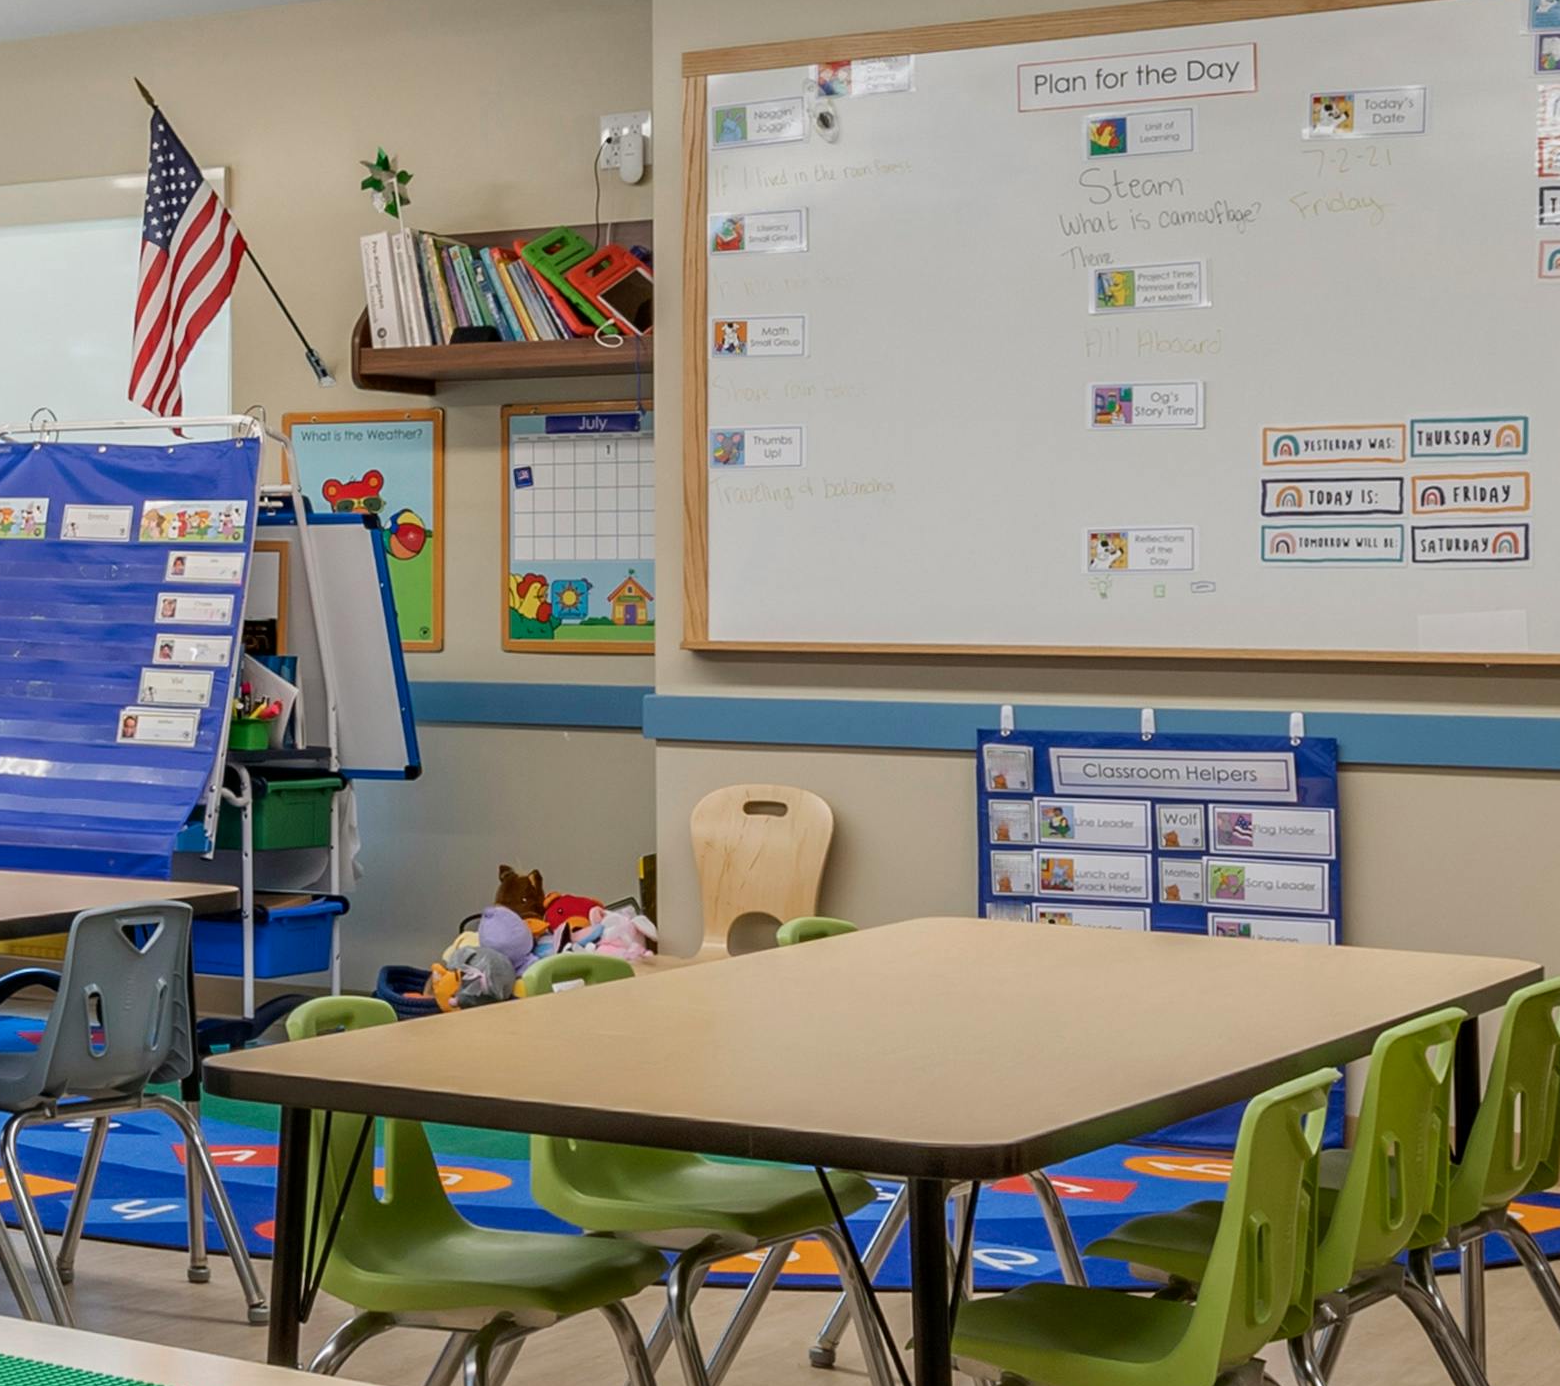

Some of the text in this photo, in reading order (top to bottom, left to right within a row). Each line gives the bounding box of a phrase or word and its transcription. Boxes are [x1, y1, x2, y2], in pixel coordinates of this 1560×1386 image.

[1034, 59, 1240, 96] Plan for the Day
[1364, 97, 1415, 112] Today's
[1372, 112, 1406, 125] Date
[1144, 120, 1174, 132] Unit of
[1139, 132, 1181, 145] Learning
[1079, 167, 1185, 206] Steam
[1288, 191, 1385, 227] Friday
[1059, 211, 1119, 238] What
[1129, 209, 1151, 231] is
[1137, 270, 1170, 283] Project
[1136, 279, 1198, 292] Primrose Early
[1142, 293, 1193, 304] Art Masters
[760, 326, 790, 337] Math
[749, 337, 801, 349] Small Group
[1150, 391, 1180, 406] Og's
[1134, 405, 1195, 419] Story Time
[577, 415, 609, 432] July
[300, 427, 424, 442] What is the Weather?
[752, 435, 794, 446] Thumbs
[1416, 428, 1493, 447] THURSDAY
[1303, 436, 1396, 453] YESTERDAY WAS:
[763, 447, 781, 461] Up!
[1308, 488, 1380, 507] TODAY IS:
[1452, 484, 1512, 504] FRIDAY
[1134, 534, 1186, 545] Reflections
[1298, 536, 1351, 550] TOMORROW
[1355, 536, 1379, 549] WILL
[1420, 537, 1490, 554] SATURDAY
[1145, 545, 1174, 555] of the
[1149, 556, 1169, 568] Day
[1081, 761, 1258, 785] Classroom Helpers
[1074, 817, 1135, 830] Line Leader
[1163, 812, 1198, 826] Wolf
[1253, 823, 1317, 837] Flag Holder
[1075, 869, 1130, 881] Lunch and
[1108, 882, 1144, 895] Helper
[1245, 877, 1318, 892] Song Leader
